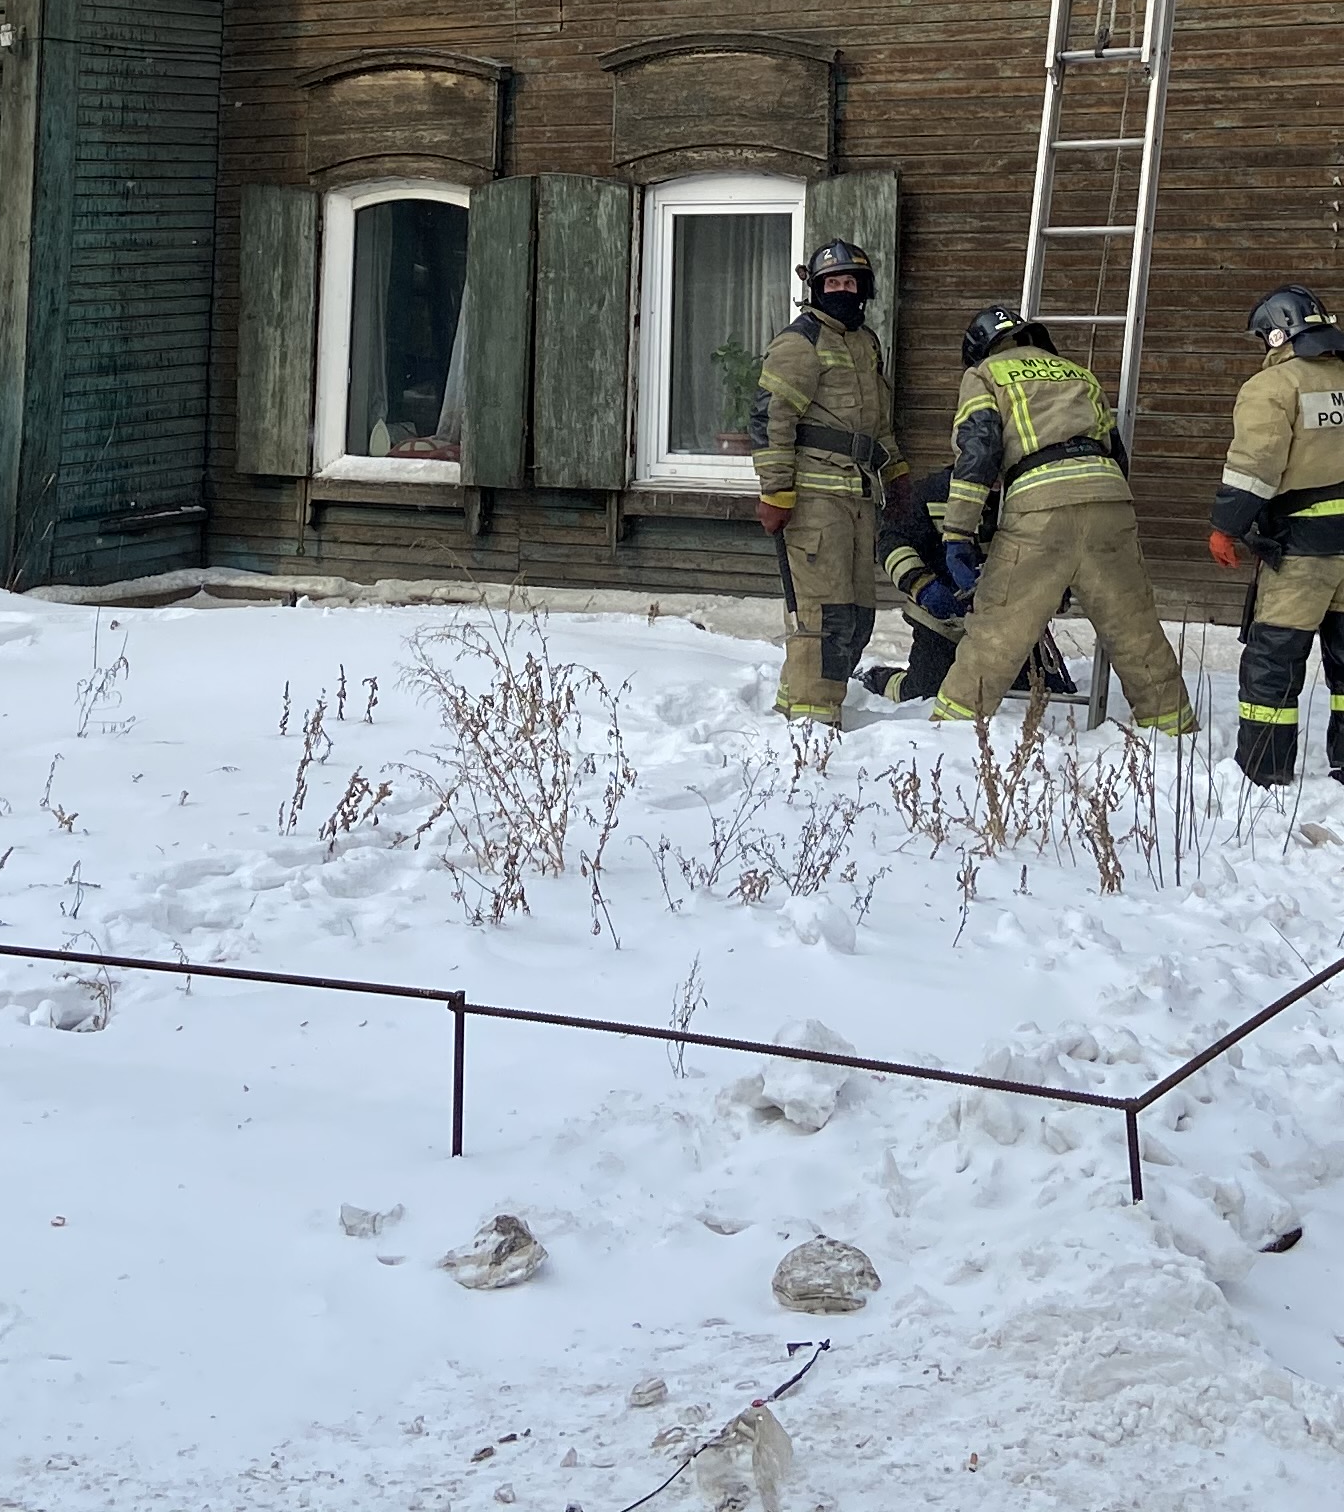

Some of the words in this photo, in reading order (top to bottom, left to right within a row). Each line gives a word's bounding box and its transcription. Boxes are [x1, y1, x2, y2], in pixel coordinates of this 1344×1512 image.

[822, 248, 833, 260] 2
[995, 311, 1007, 321] 2
[1020, 359, 1063, 368] МЧС
[1008, 369, 1088, 382] РОССИИ
